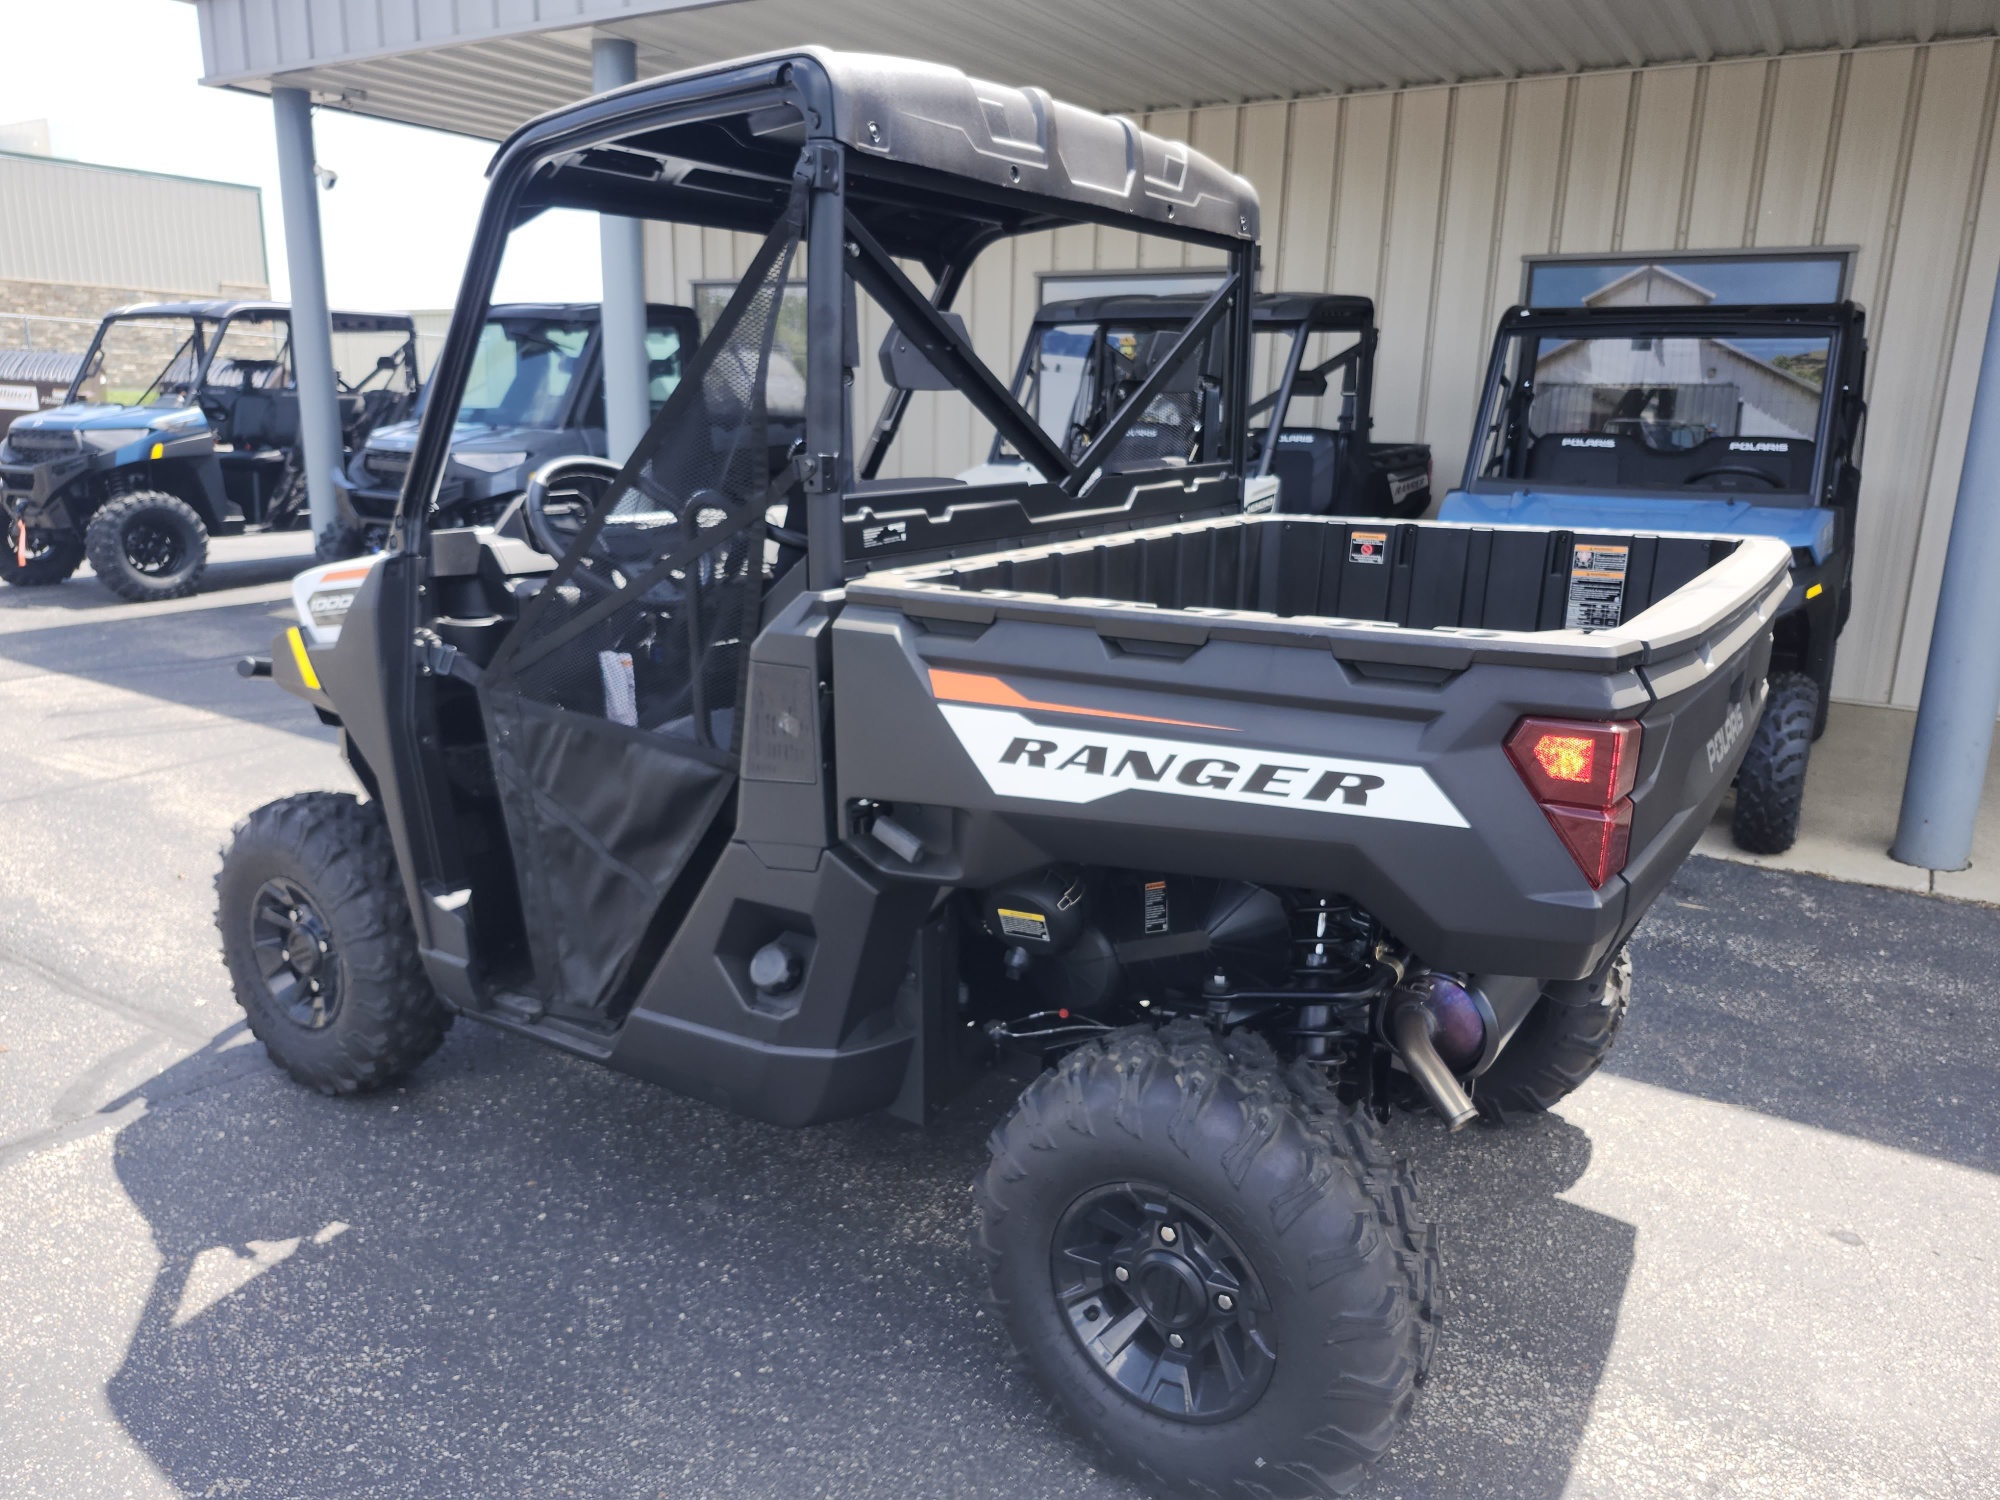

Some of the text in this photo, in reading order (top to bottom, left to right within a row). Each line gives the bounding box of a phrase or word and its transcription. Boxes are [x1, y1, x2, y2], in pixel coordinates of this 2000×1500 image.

[1561, 437, 1616, 449] POLARIS
[1728, 441, 1789, 453] POLARIS
[310, 593, 355, 612] 1000
[998, 736, 1386, 807] RANGER
